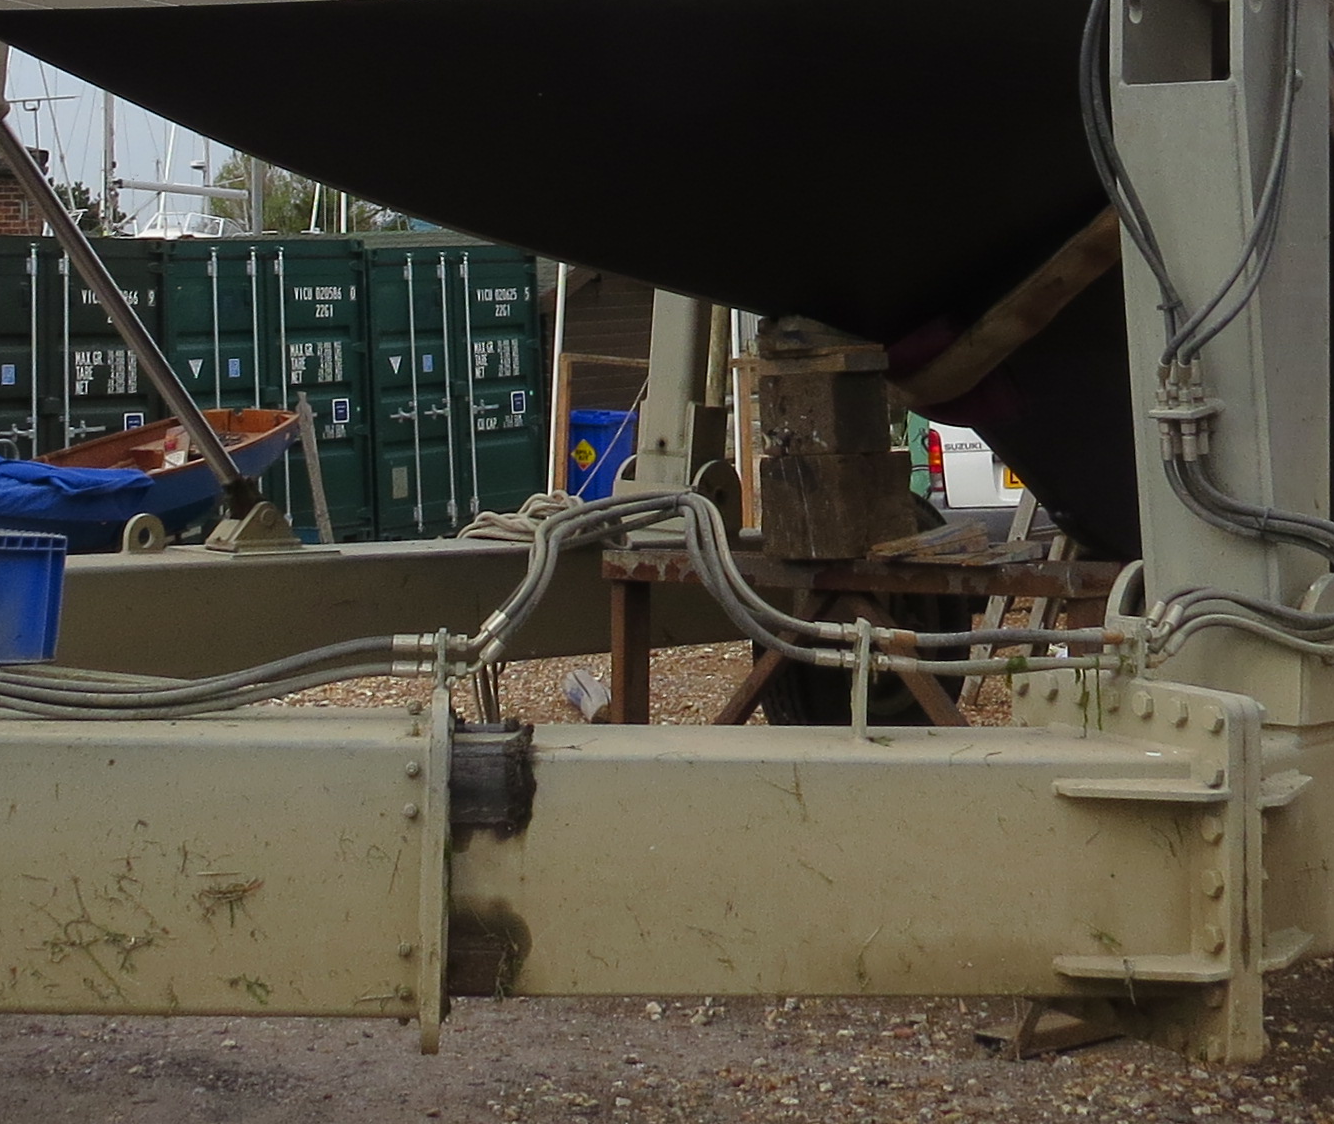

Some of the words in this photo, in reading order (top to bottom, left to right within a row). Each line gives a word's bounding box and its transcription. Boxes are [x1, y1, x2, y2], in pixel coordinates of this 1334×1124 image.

[294, 287, 313, 300] VICU
[315, 286, 342, 300] 020586
[476, 288, 493, 301] VICU
[494, 287, 518, 301] 020625
[524, 287, 530, 301] 5
[291, 356, 307, 370] TARE
[475, 354, 488, 367] TARE
[76, 366, 94, 380] TARE
[291, 370, 302, 384] NET
[475, 366, 485, 379] NET
[75, 380, 89, 395] NET
[944, 442, 982, 451] SUZUKI
